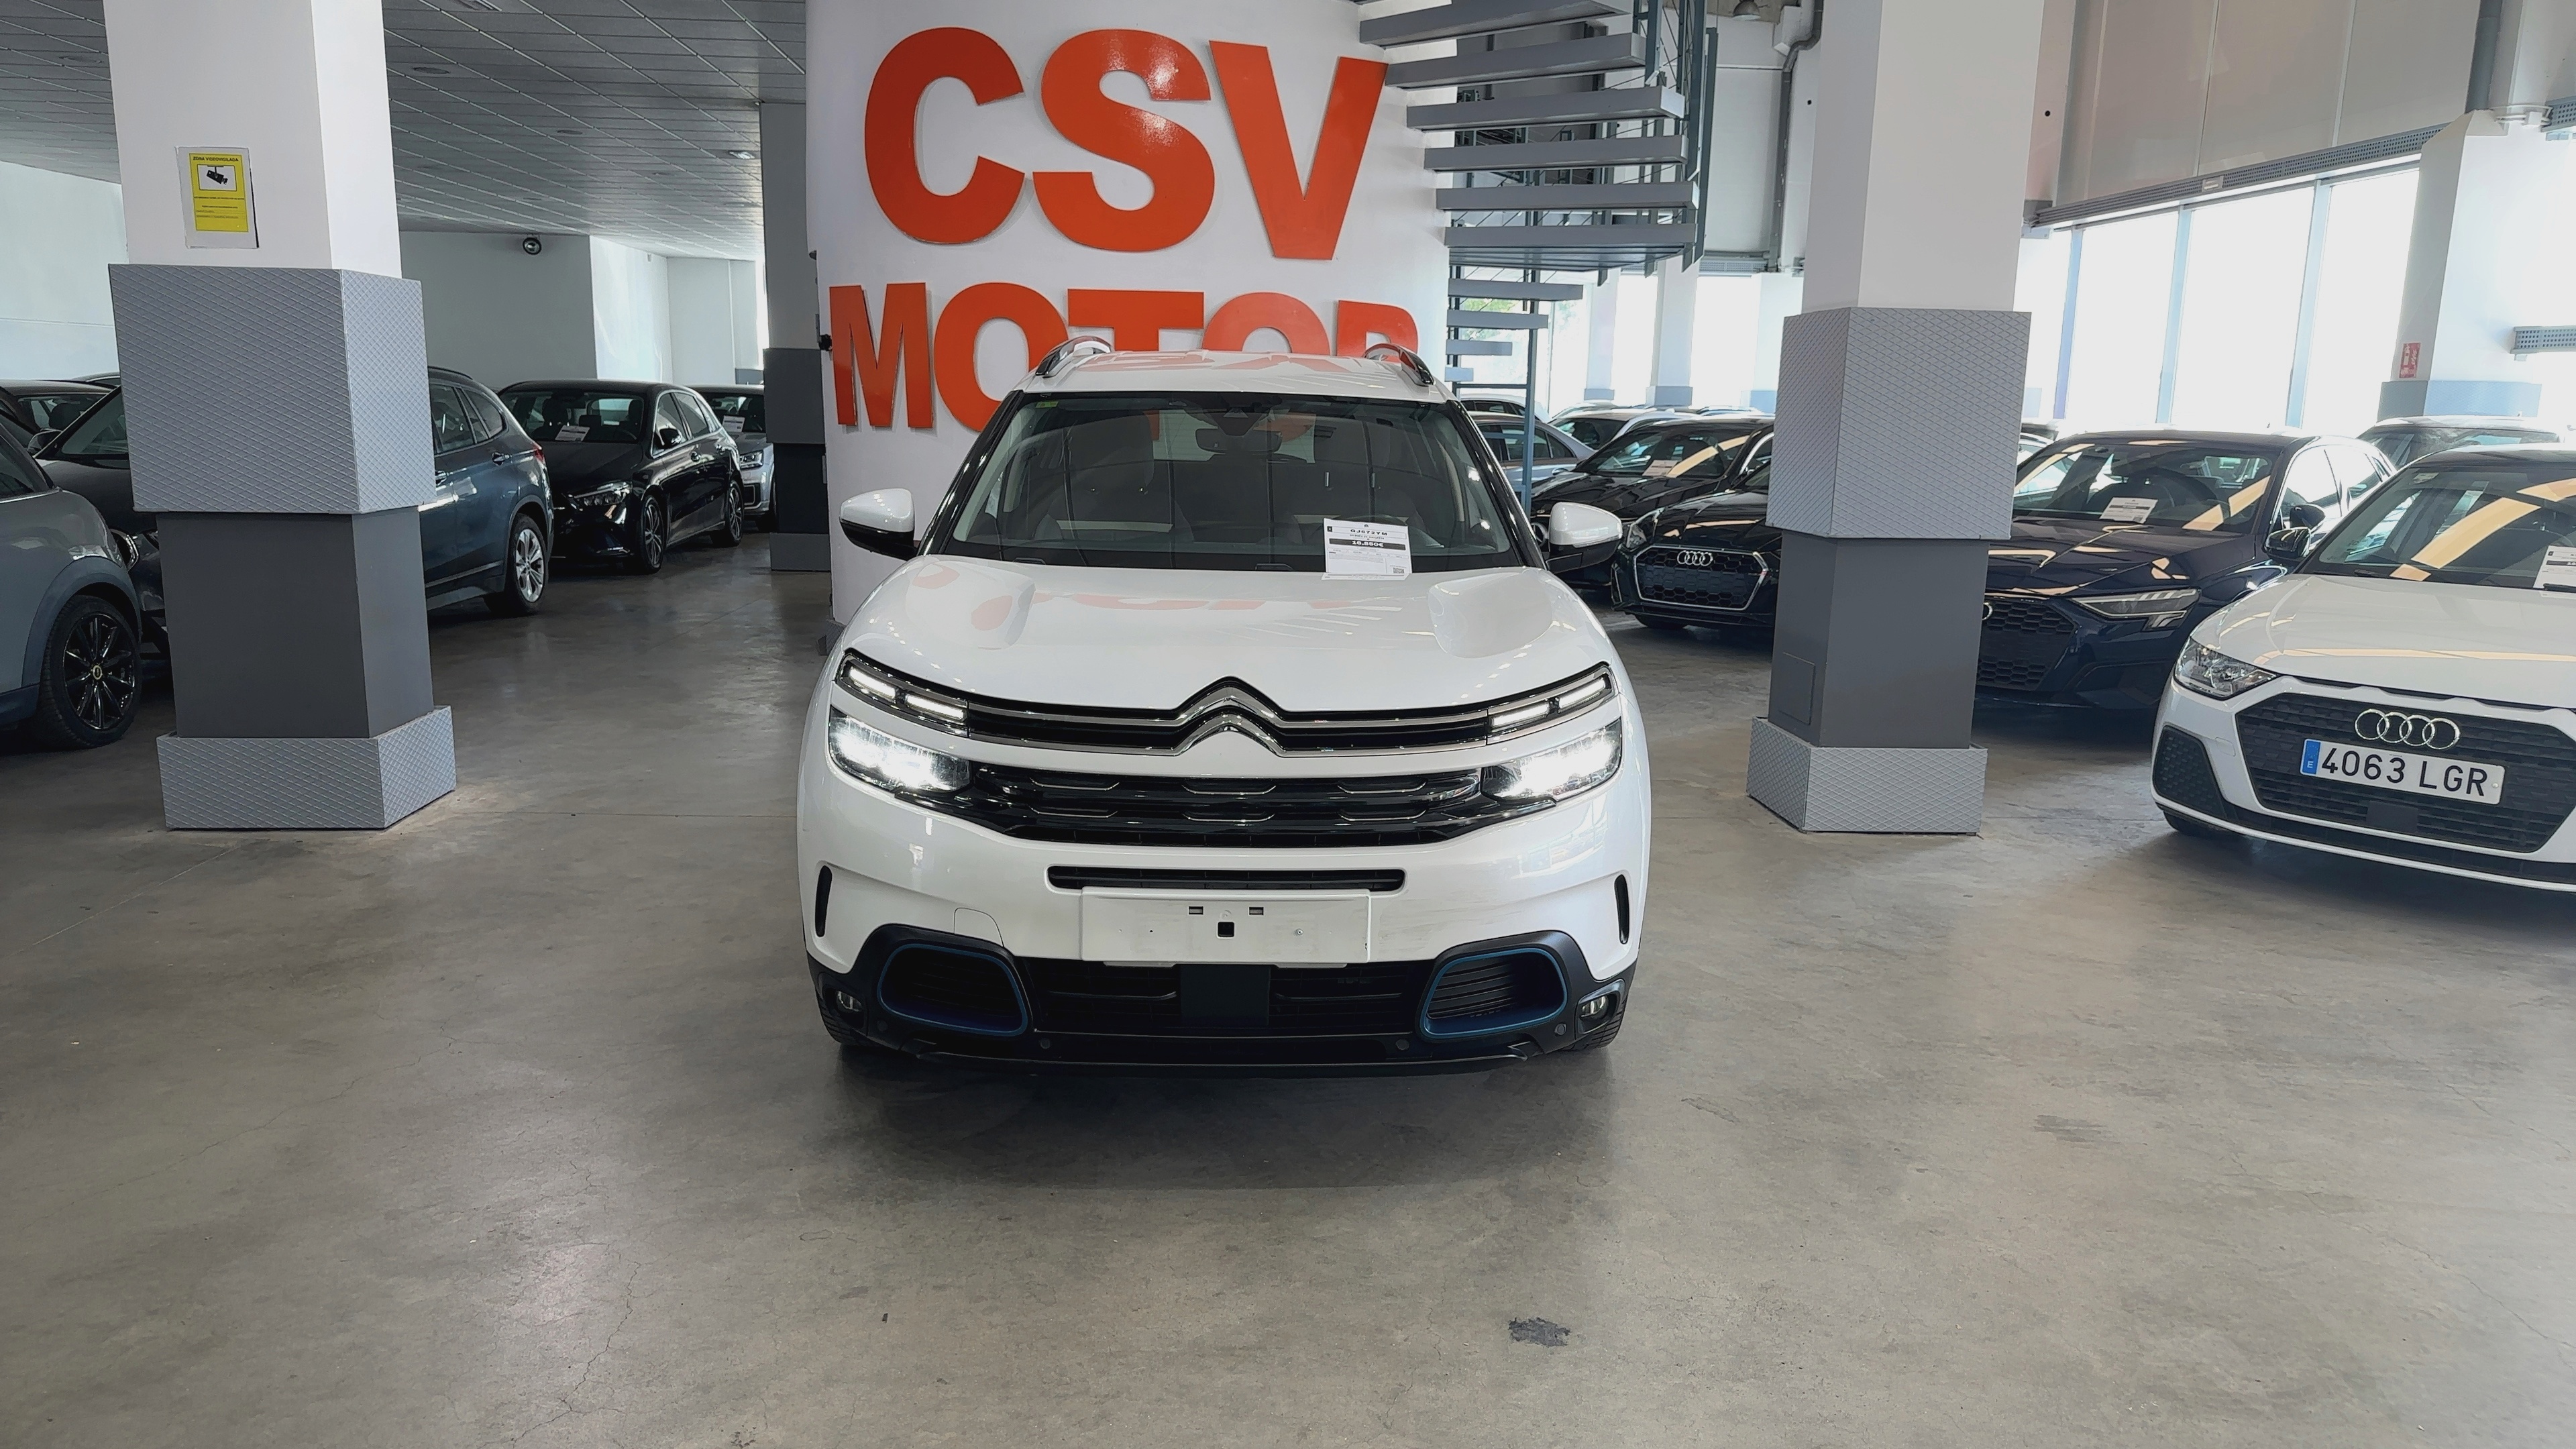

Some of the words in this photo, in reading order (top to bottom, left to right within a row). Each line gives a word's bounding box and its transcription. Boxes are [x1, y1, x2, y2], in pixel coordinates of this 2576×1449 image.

[864, 27, 1388, 260] CSV
[2306, 761, 2314, 769] E
[2321, 747, 2406, 784] 4063
[2418, 761, 2488, 797] LGR
